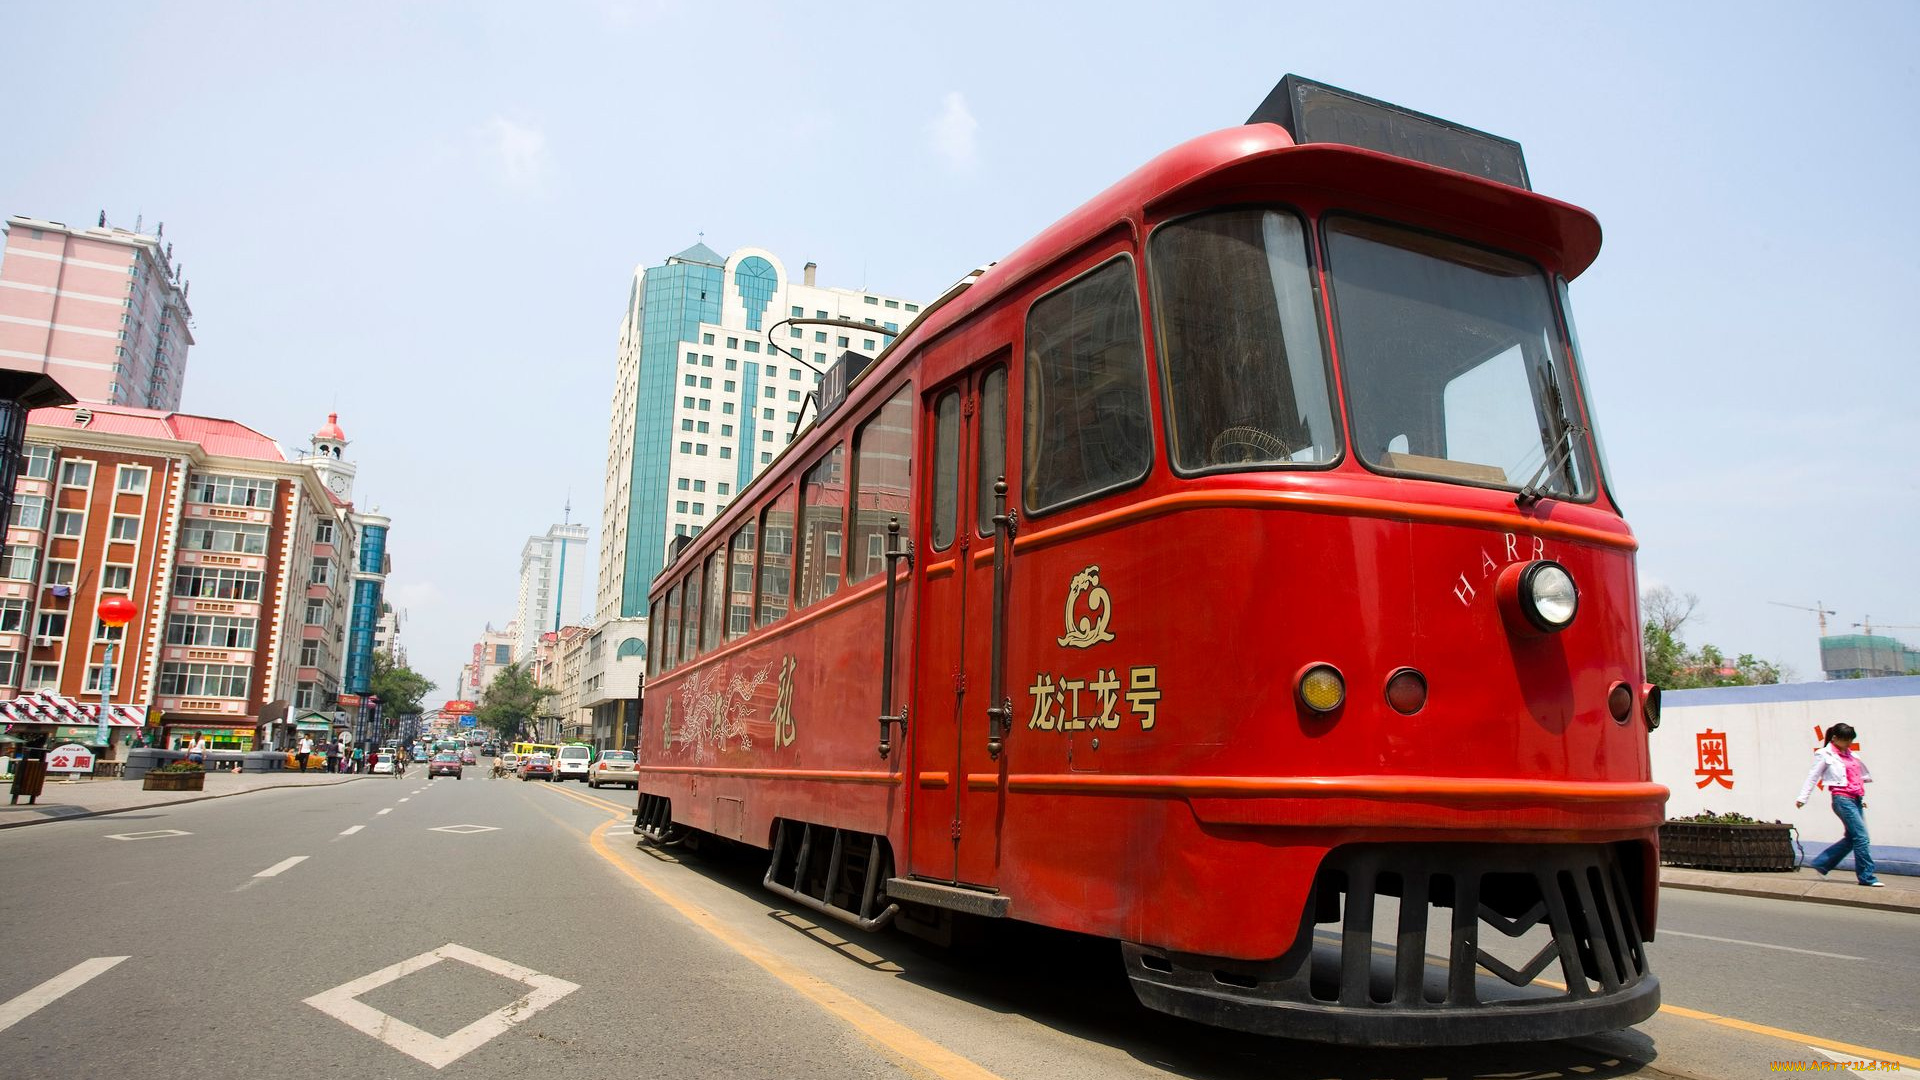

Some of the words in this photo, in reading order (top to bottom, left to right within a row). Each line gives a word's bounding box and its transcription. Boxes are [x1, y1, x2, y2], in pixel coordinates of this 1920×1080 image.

[1453, 532, 1582, 607] HARB
[1028, 666, 1162, 732] 龙江龙号
[51, 755, 92, 769] 公厕
[1694, 728, 1734, 790] 奥
